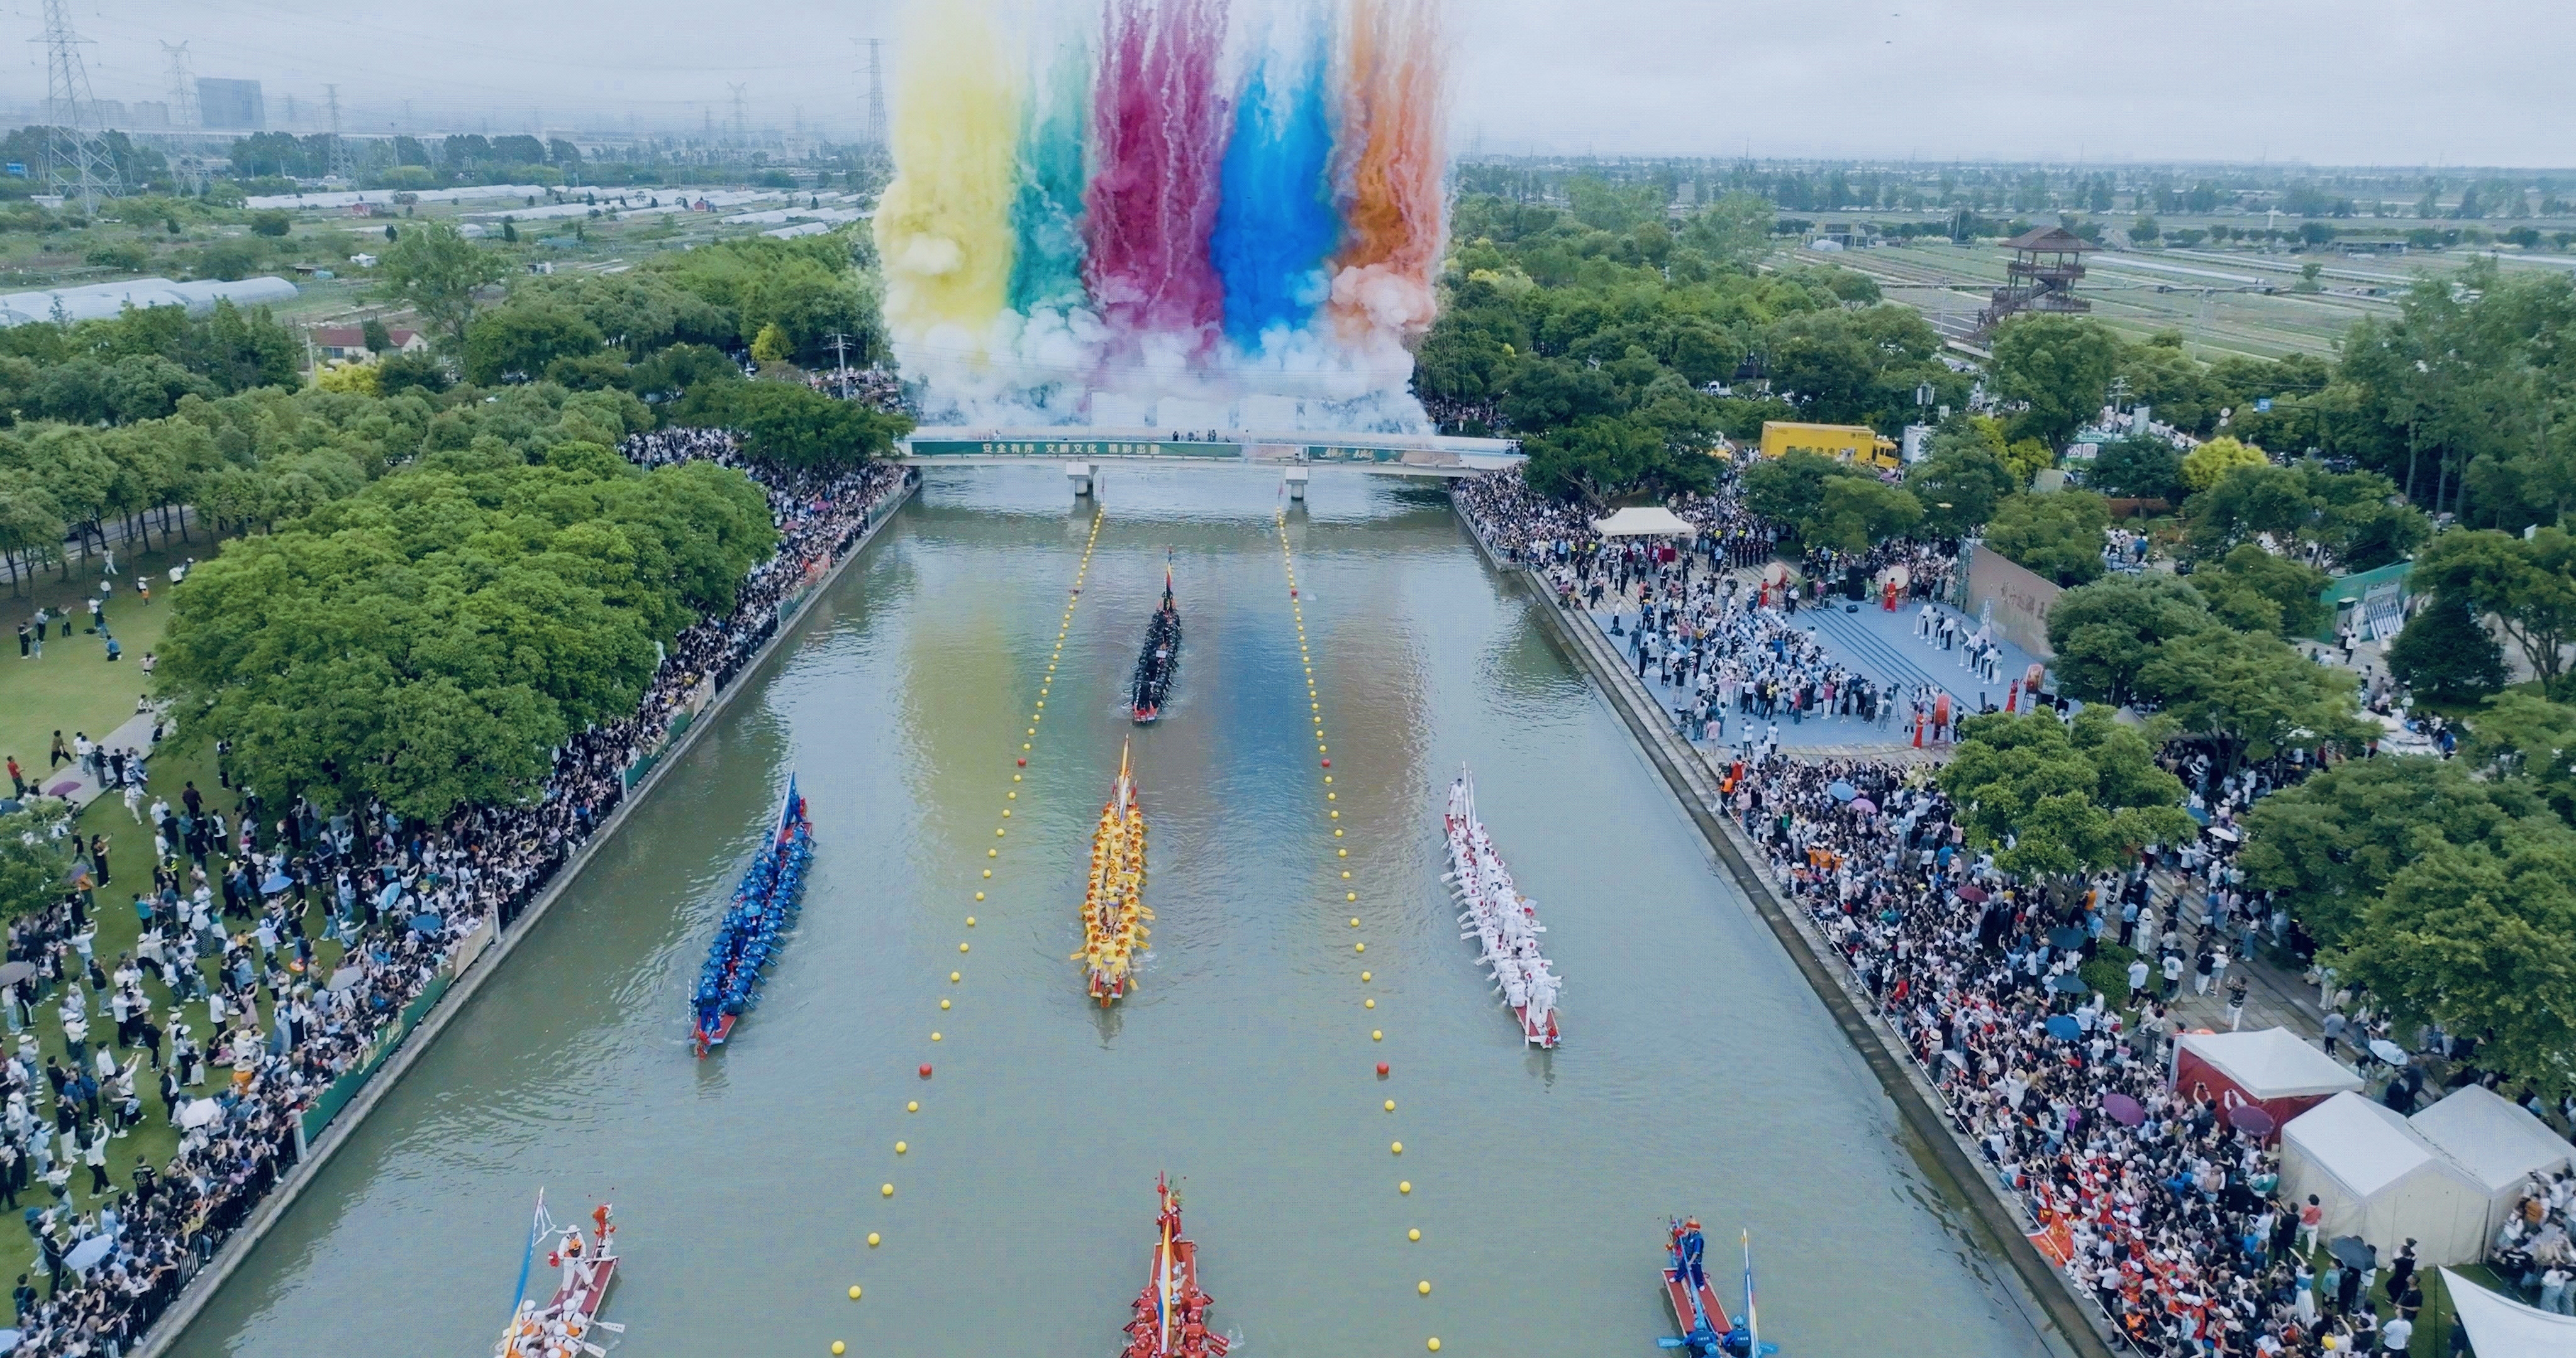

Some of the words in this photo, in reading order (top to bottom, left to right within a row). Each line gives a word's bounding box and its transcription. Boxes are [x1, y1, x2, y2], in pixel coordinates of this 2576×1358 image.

[982, 443, 1034, 454] 安全有序
[1045, 443, 1097, 454] 文明文化
